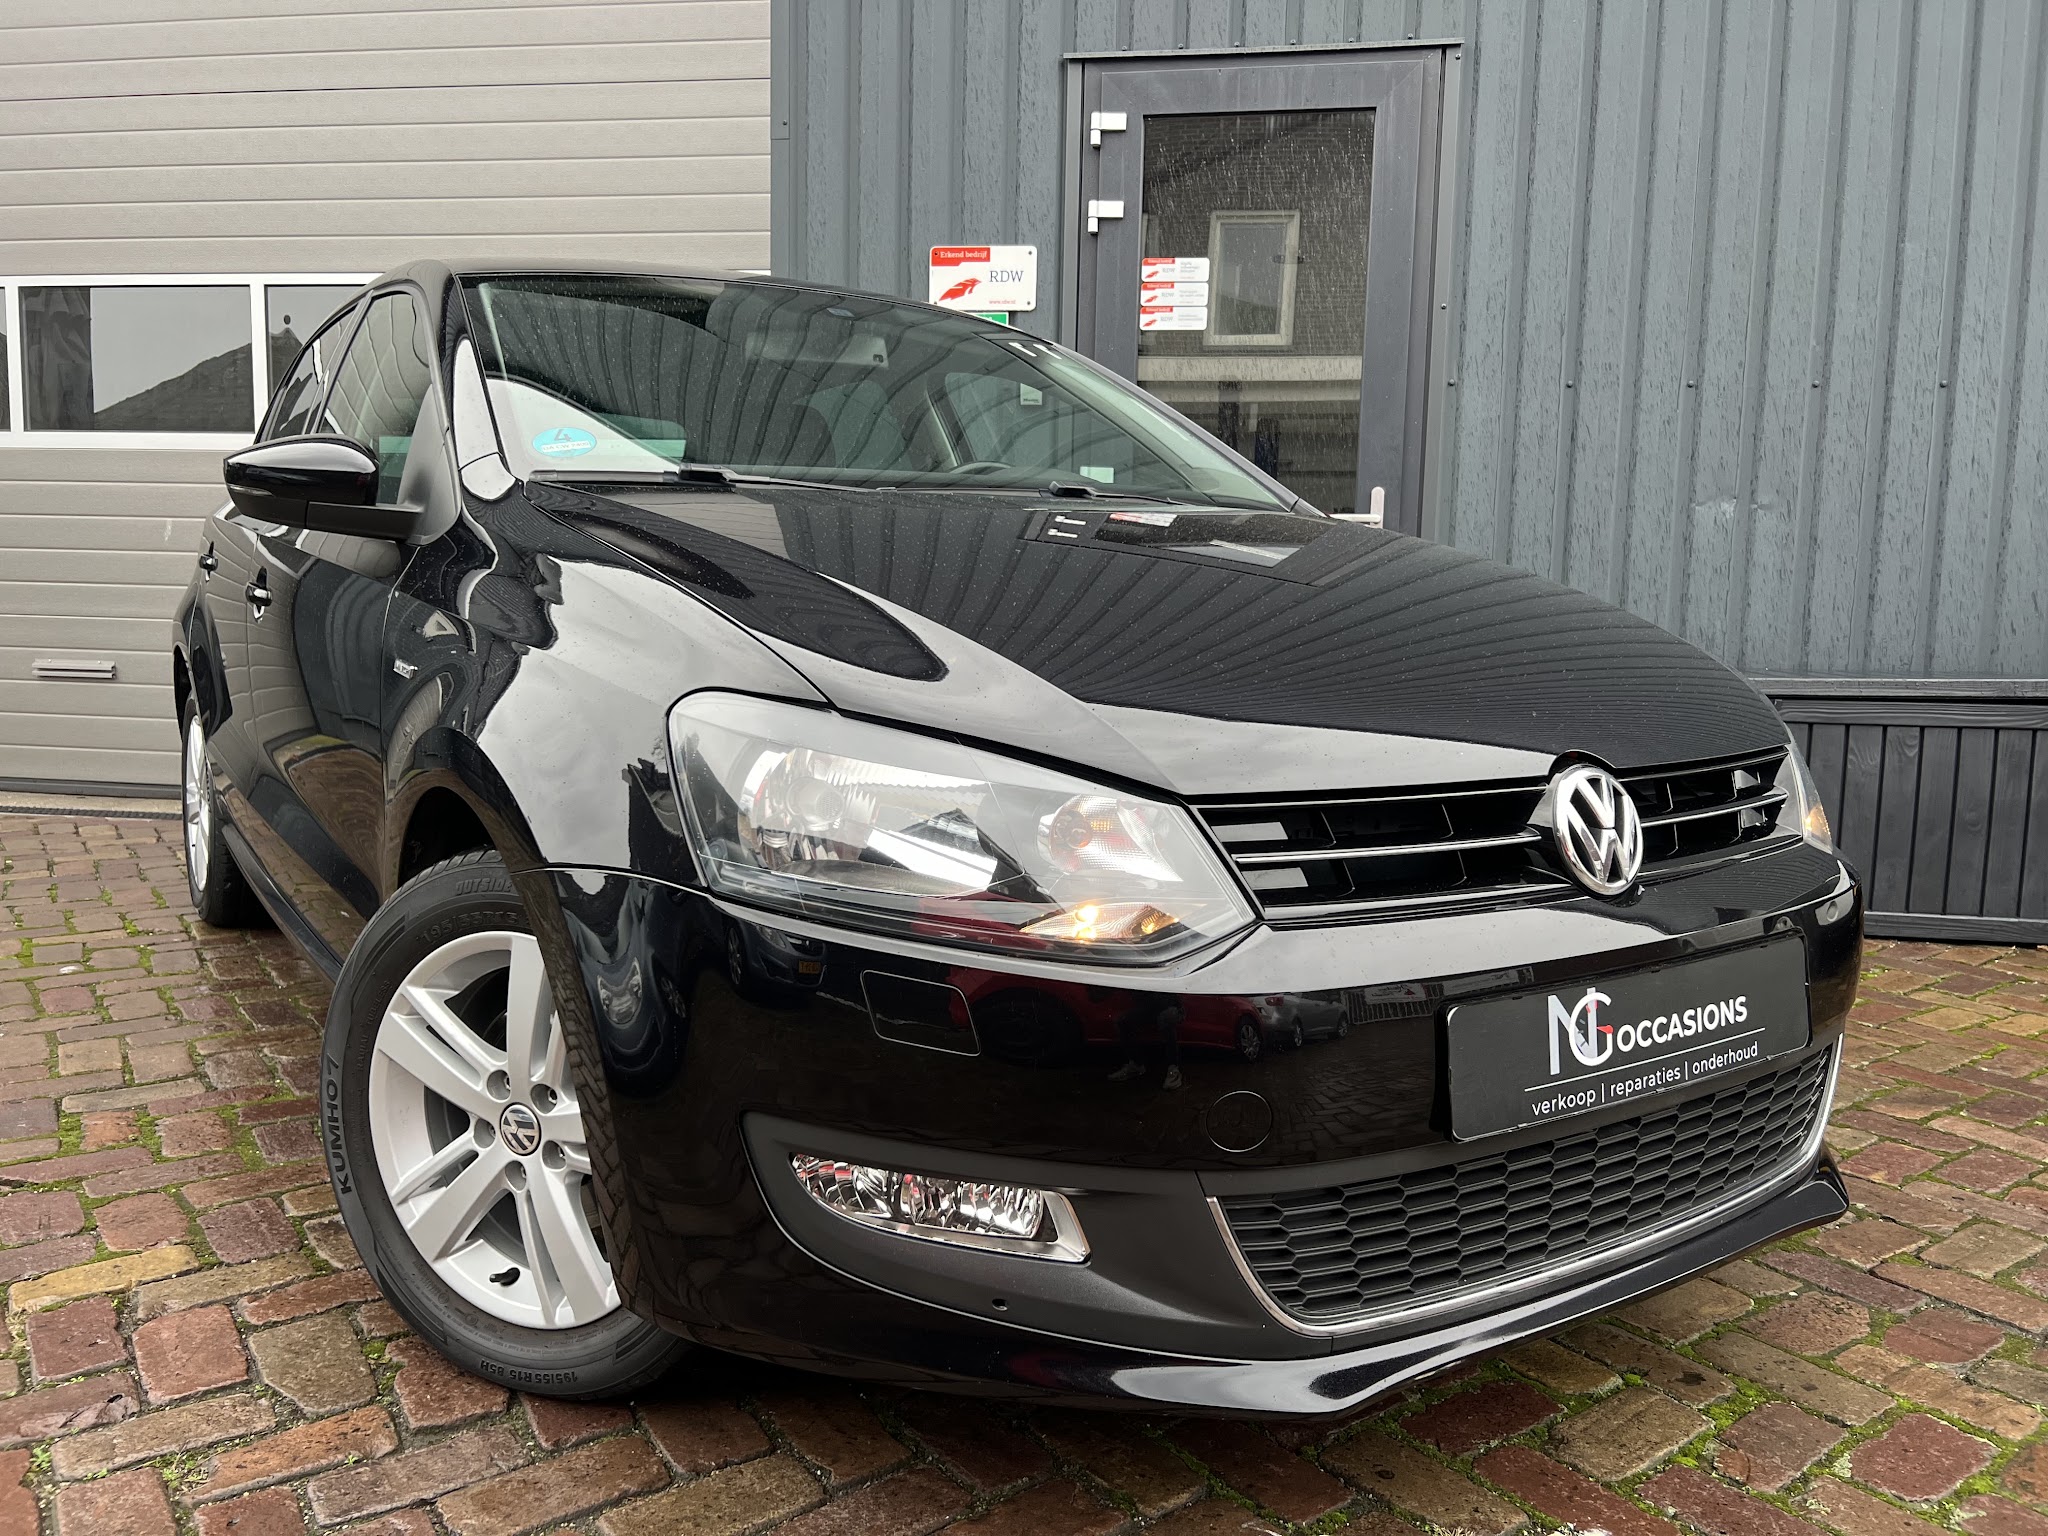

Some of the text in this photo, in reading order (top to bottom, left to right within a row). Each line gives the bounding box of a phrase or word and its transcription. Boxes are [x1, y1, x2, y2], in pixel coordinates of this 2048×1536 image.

[940, 250, 987, 259] Erkend bedrijf
[989, 270, 1024, 283] RDW
[1616, 995, 1748, 1053] OCCASIONS
[1531, 1041, 1759, 1117] verkoop reparaties onderhoud
[326, 1078, 352, 1195] KUMHO
